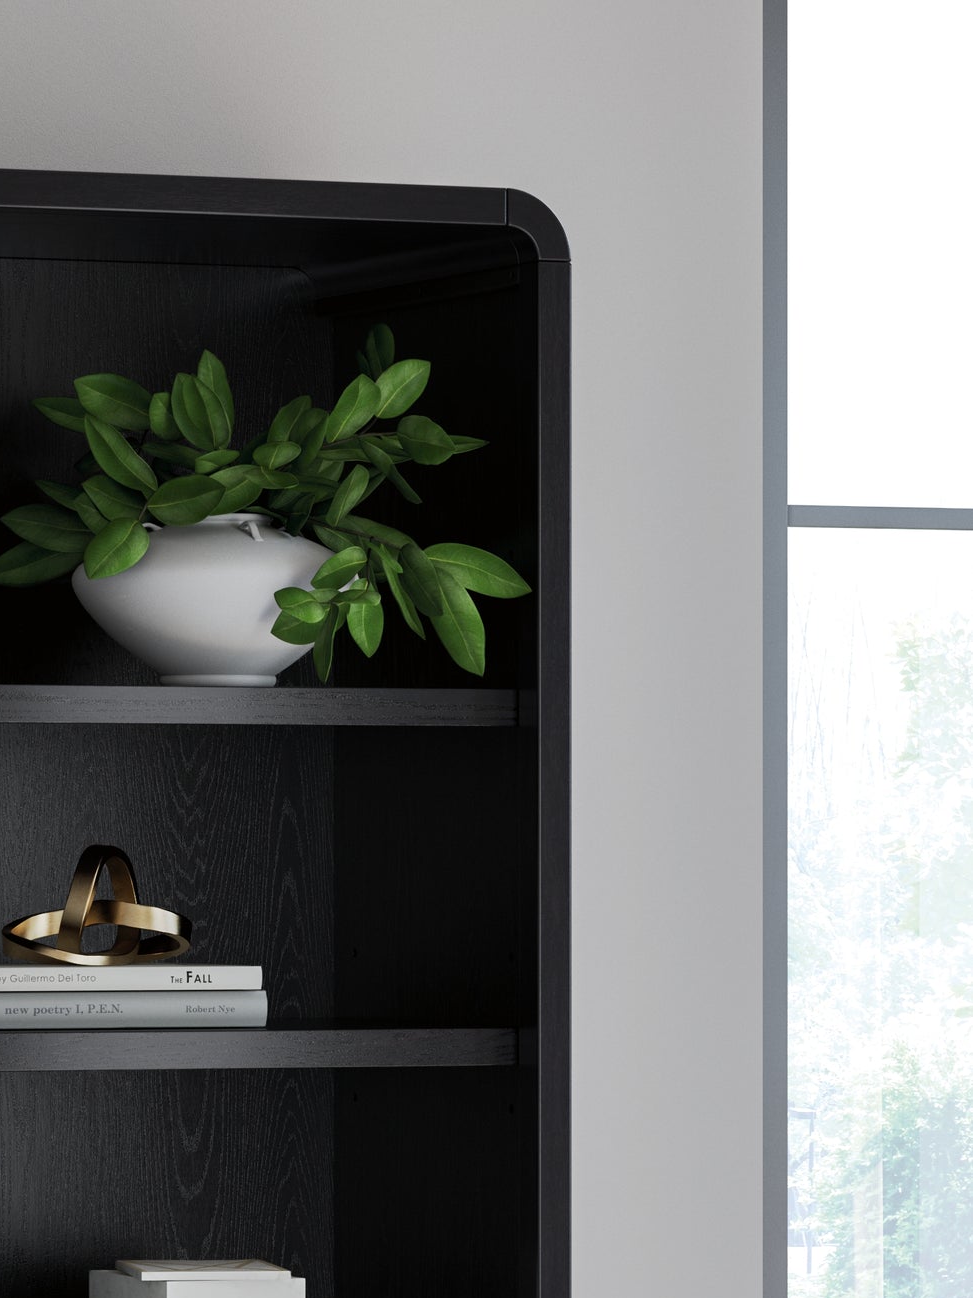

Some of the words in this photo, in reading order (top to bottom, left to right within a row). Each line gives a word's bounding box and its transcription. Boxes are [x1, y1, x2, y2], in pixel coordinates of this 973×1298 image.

[9, 974, 56, 984] Guillermo
[58, 974, 74, 983] Del
[76, 973, 97, 983] Toro
[170, 975, 183, 984] THE
[186, 971, 213, 984] FALL
[4, 1006, 29, 1015] new
[33, 1005, 72, 1016] poetry
[87, 1003, 124, 1014] P.E.N.
[185, 1005, 216, 1014] Robert
[218, 1005, 236, 1015] Nye
